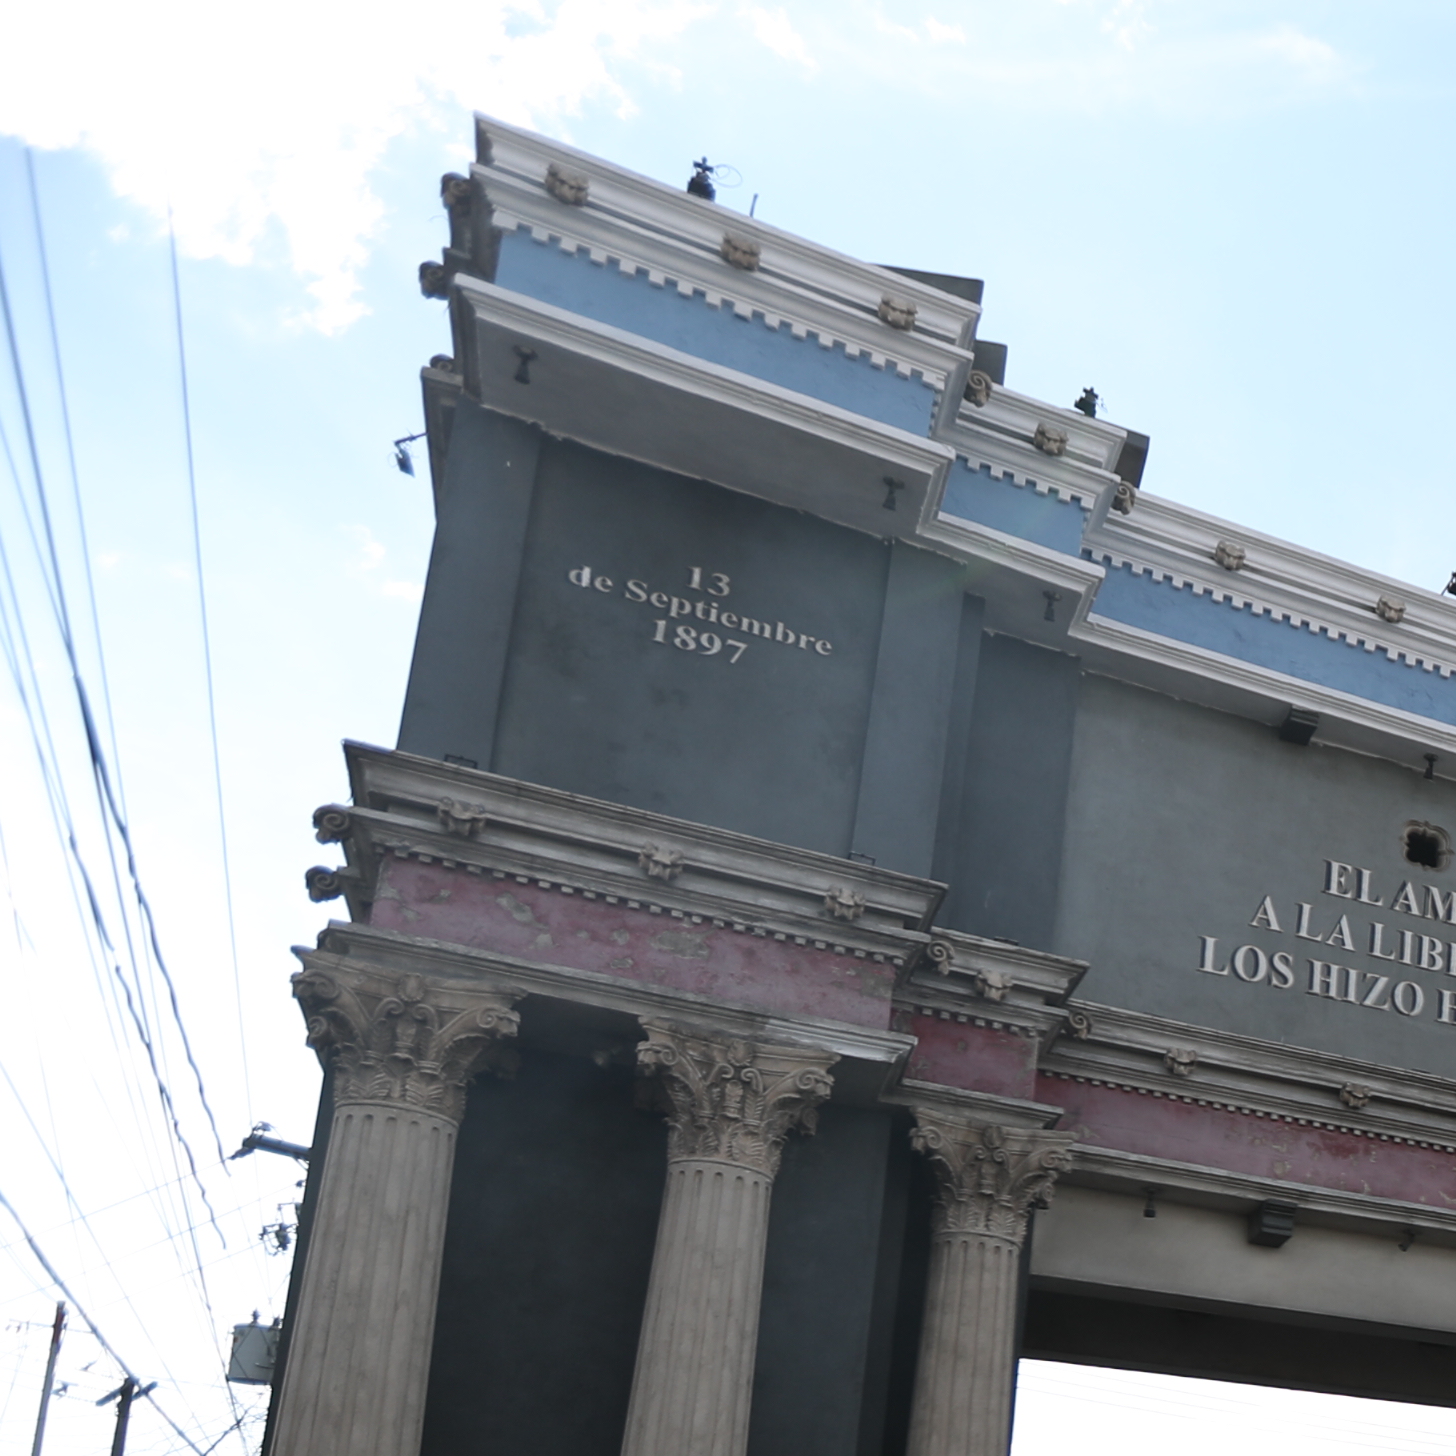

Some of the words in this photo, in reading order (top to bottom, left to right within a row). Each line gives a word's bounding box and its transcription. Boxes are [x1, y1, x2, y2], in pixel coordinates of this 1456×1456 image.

[686, 566, 731, 596] 13
[568, 565, 613, 593] de
[625, 579, 832, 656] Septiembre
[651, 619, 748, 664] 1897
[1322, 859, 1384, 907] EL
[1250, 895, 1283, 933] A
[1295, 902, 1356, 951] LA
[1196, 935, 1294, 989] LOS
[1307, 958, 1425, 1017] HIZO
